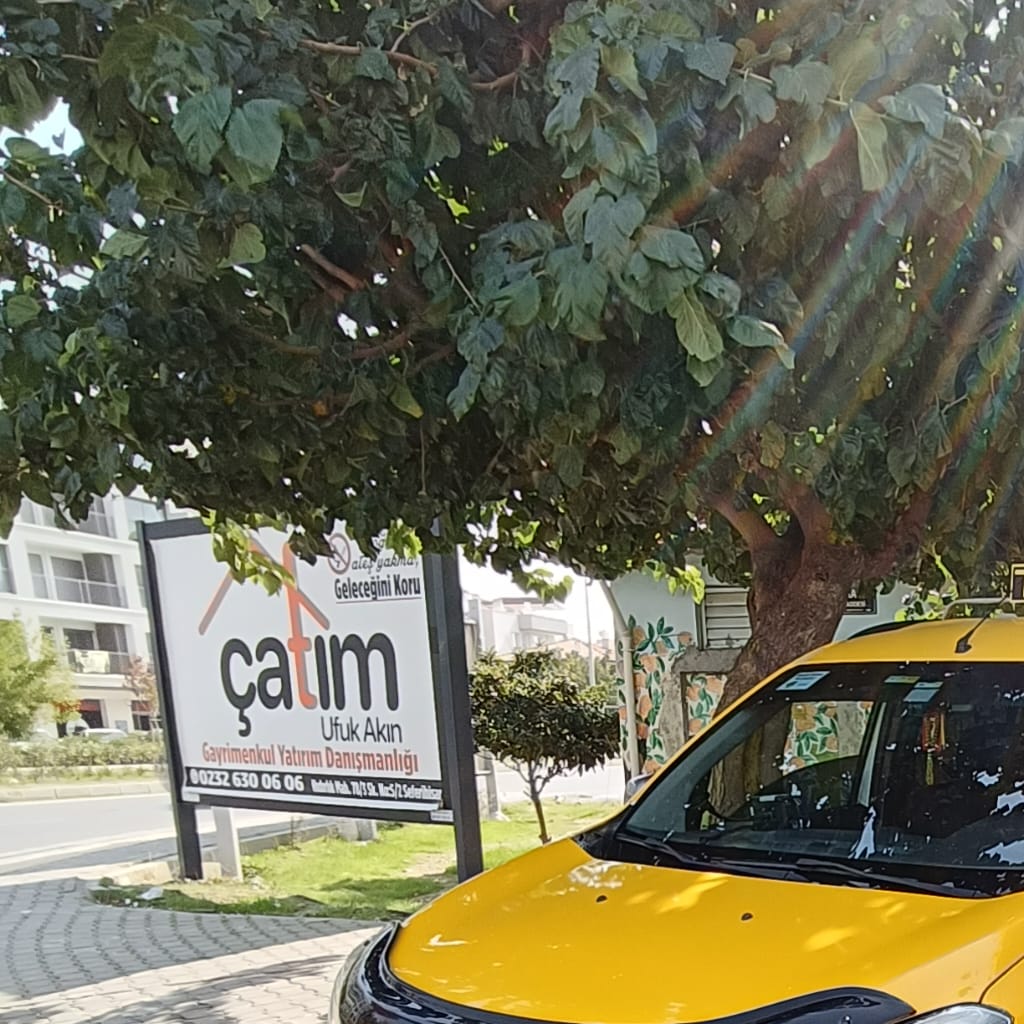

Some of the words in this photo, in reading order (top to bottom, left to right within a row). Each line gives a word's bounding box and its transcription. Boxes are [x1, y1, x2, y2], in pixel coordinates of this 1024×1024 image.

[334, 574, 392, 600] Geleceğini
[393, 574, 421, 596] Koru
[220, 632, 399, 737] çatım
[320, 715, 358, 741] Ufuk
[363, 718, 402, 743] Akın
[202, 742, 275, 766] Gayrimenkul
[277, 744, 322, 768] Yatırım
[325, 746, 418, 775] Danışmanlığı
[198, 769, 231, 787] 0232
[232, 771, 258, 788] 630
[261, 773, 281, 790] 06
[283, 774, 305, 791] 06
